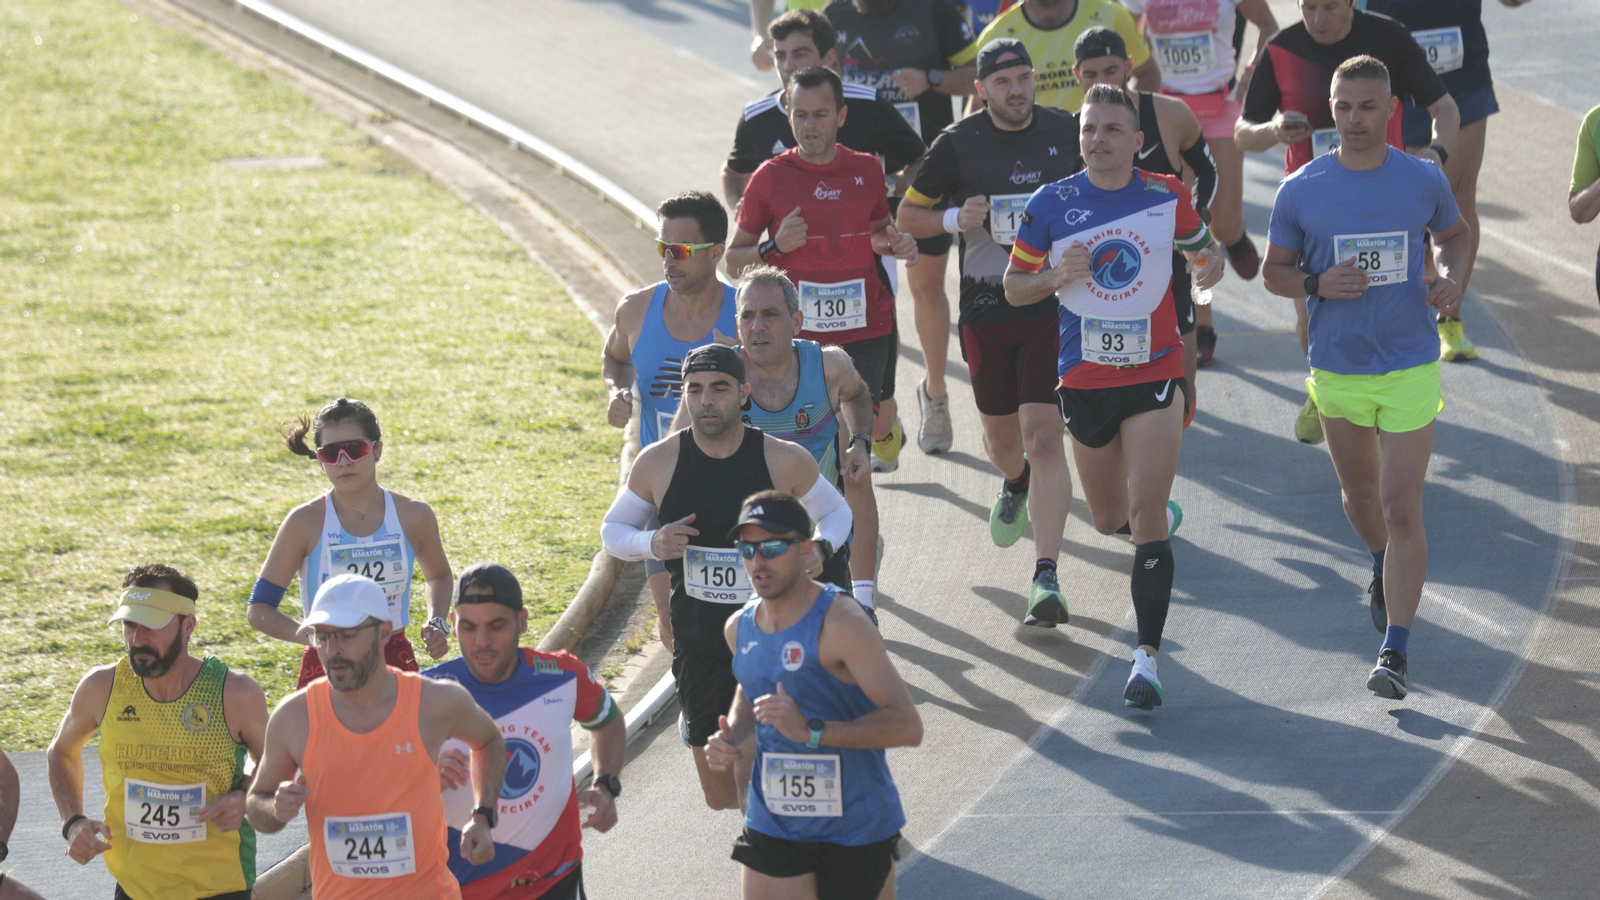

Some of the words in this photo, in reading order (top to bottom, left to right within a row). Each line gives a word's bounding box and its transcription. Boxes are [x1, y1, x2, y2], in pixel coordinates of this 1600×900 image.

[1164, 47, 1201, 65] 1005
[1128, 230, 1151, 255] TEAM
[1356, 239, 1386, 248] MARATÓN
[1358, 251, 1381, 270] 58
[1085, 280, 1144, 301] ALGECIRAS
[814, 298, 846, 318] 130
[815, 321, 847, 329] EVOS
[1101, 322, 1131, 330] MARATÓN
[1101, 332, 1125, 352] 93
[1097, 355, 1130, 363] EVOS
[351, 548, 383, 559] MARATÓN
[705, 554, 737, 563] MARATÓN
[347, 560, 386, 582] 242
[700, 565, 737, 587] 150
[702, 591, 737, 600] EVOS
[524, 726, 551, 754] TEAM
[115, 743, 208, 762] RUTEROS
[147, 789, 180, 800] MARATÓN
[779, 774, 816, 798] 155
[140, 802, 180, 827] 245
[781, 804, 817, 813] EVOS
[141, 831, 180, 840] EVOS
[349, 822, 384, 833] MARATÓN
[344, 836, 387, 860] 244
[351, 866, 390, 875] EVOS
